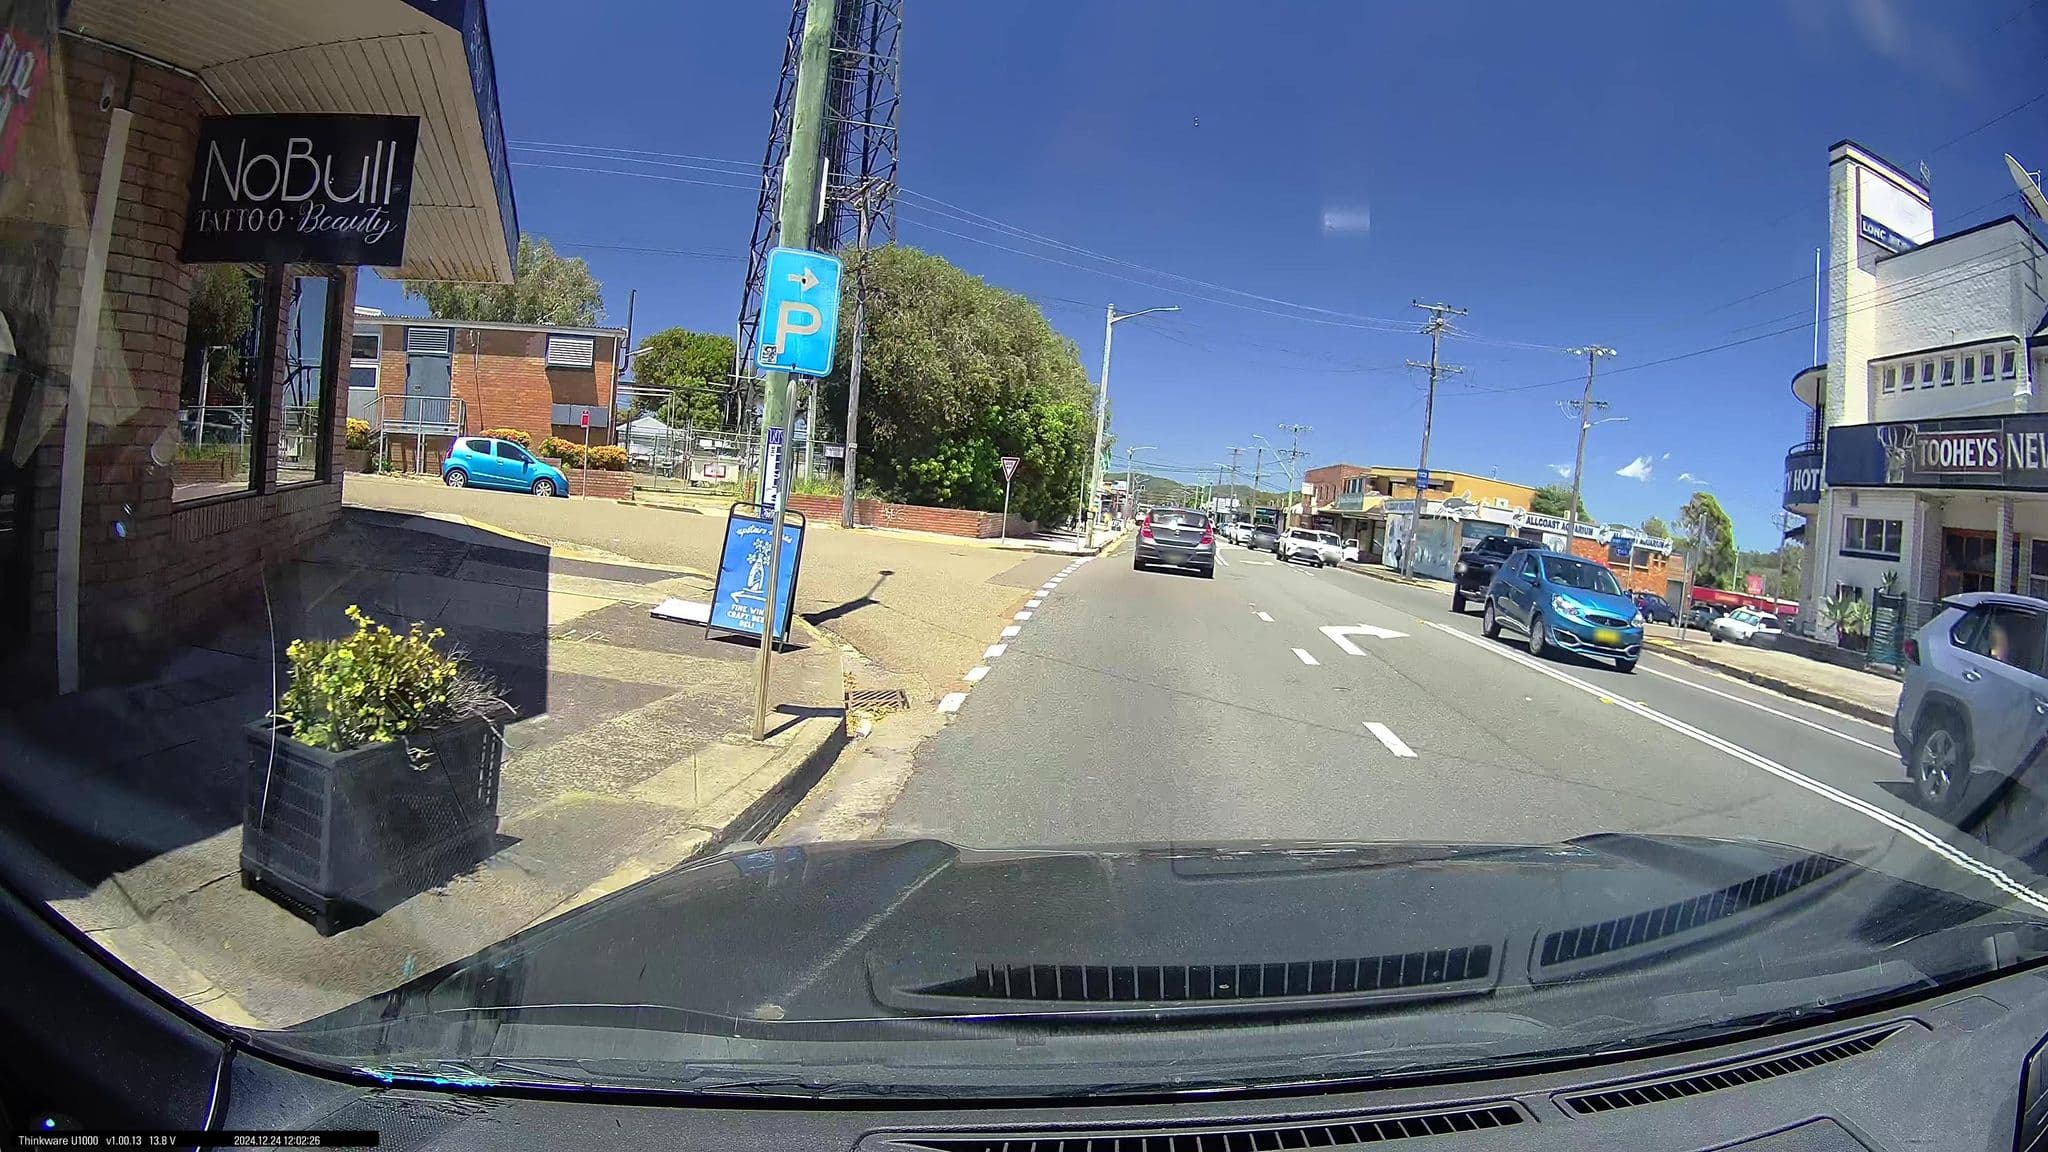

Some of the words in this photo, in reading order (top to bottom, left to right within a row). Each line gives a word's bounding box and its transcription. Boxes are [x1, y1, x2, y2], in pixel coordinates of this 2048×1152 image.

[202, 138, 397, 205] NoBull
[199, 207, 283, 232] TATTOO
[297, 200, 398, 244] Beauty
[775, 300, 822, 354] P
[1920, 438, 1998, 467] TOOHEYS
[1526, 516, 1560, 530] ALLCOAST
[727, 611, 750, 621] CRAFT
